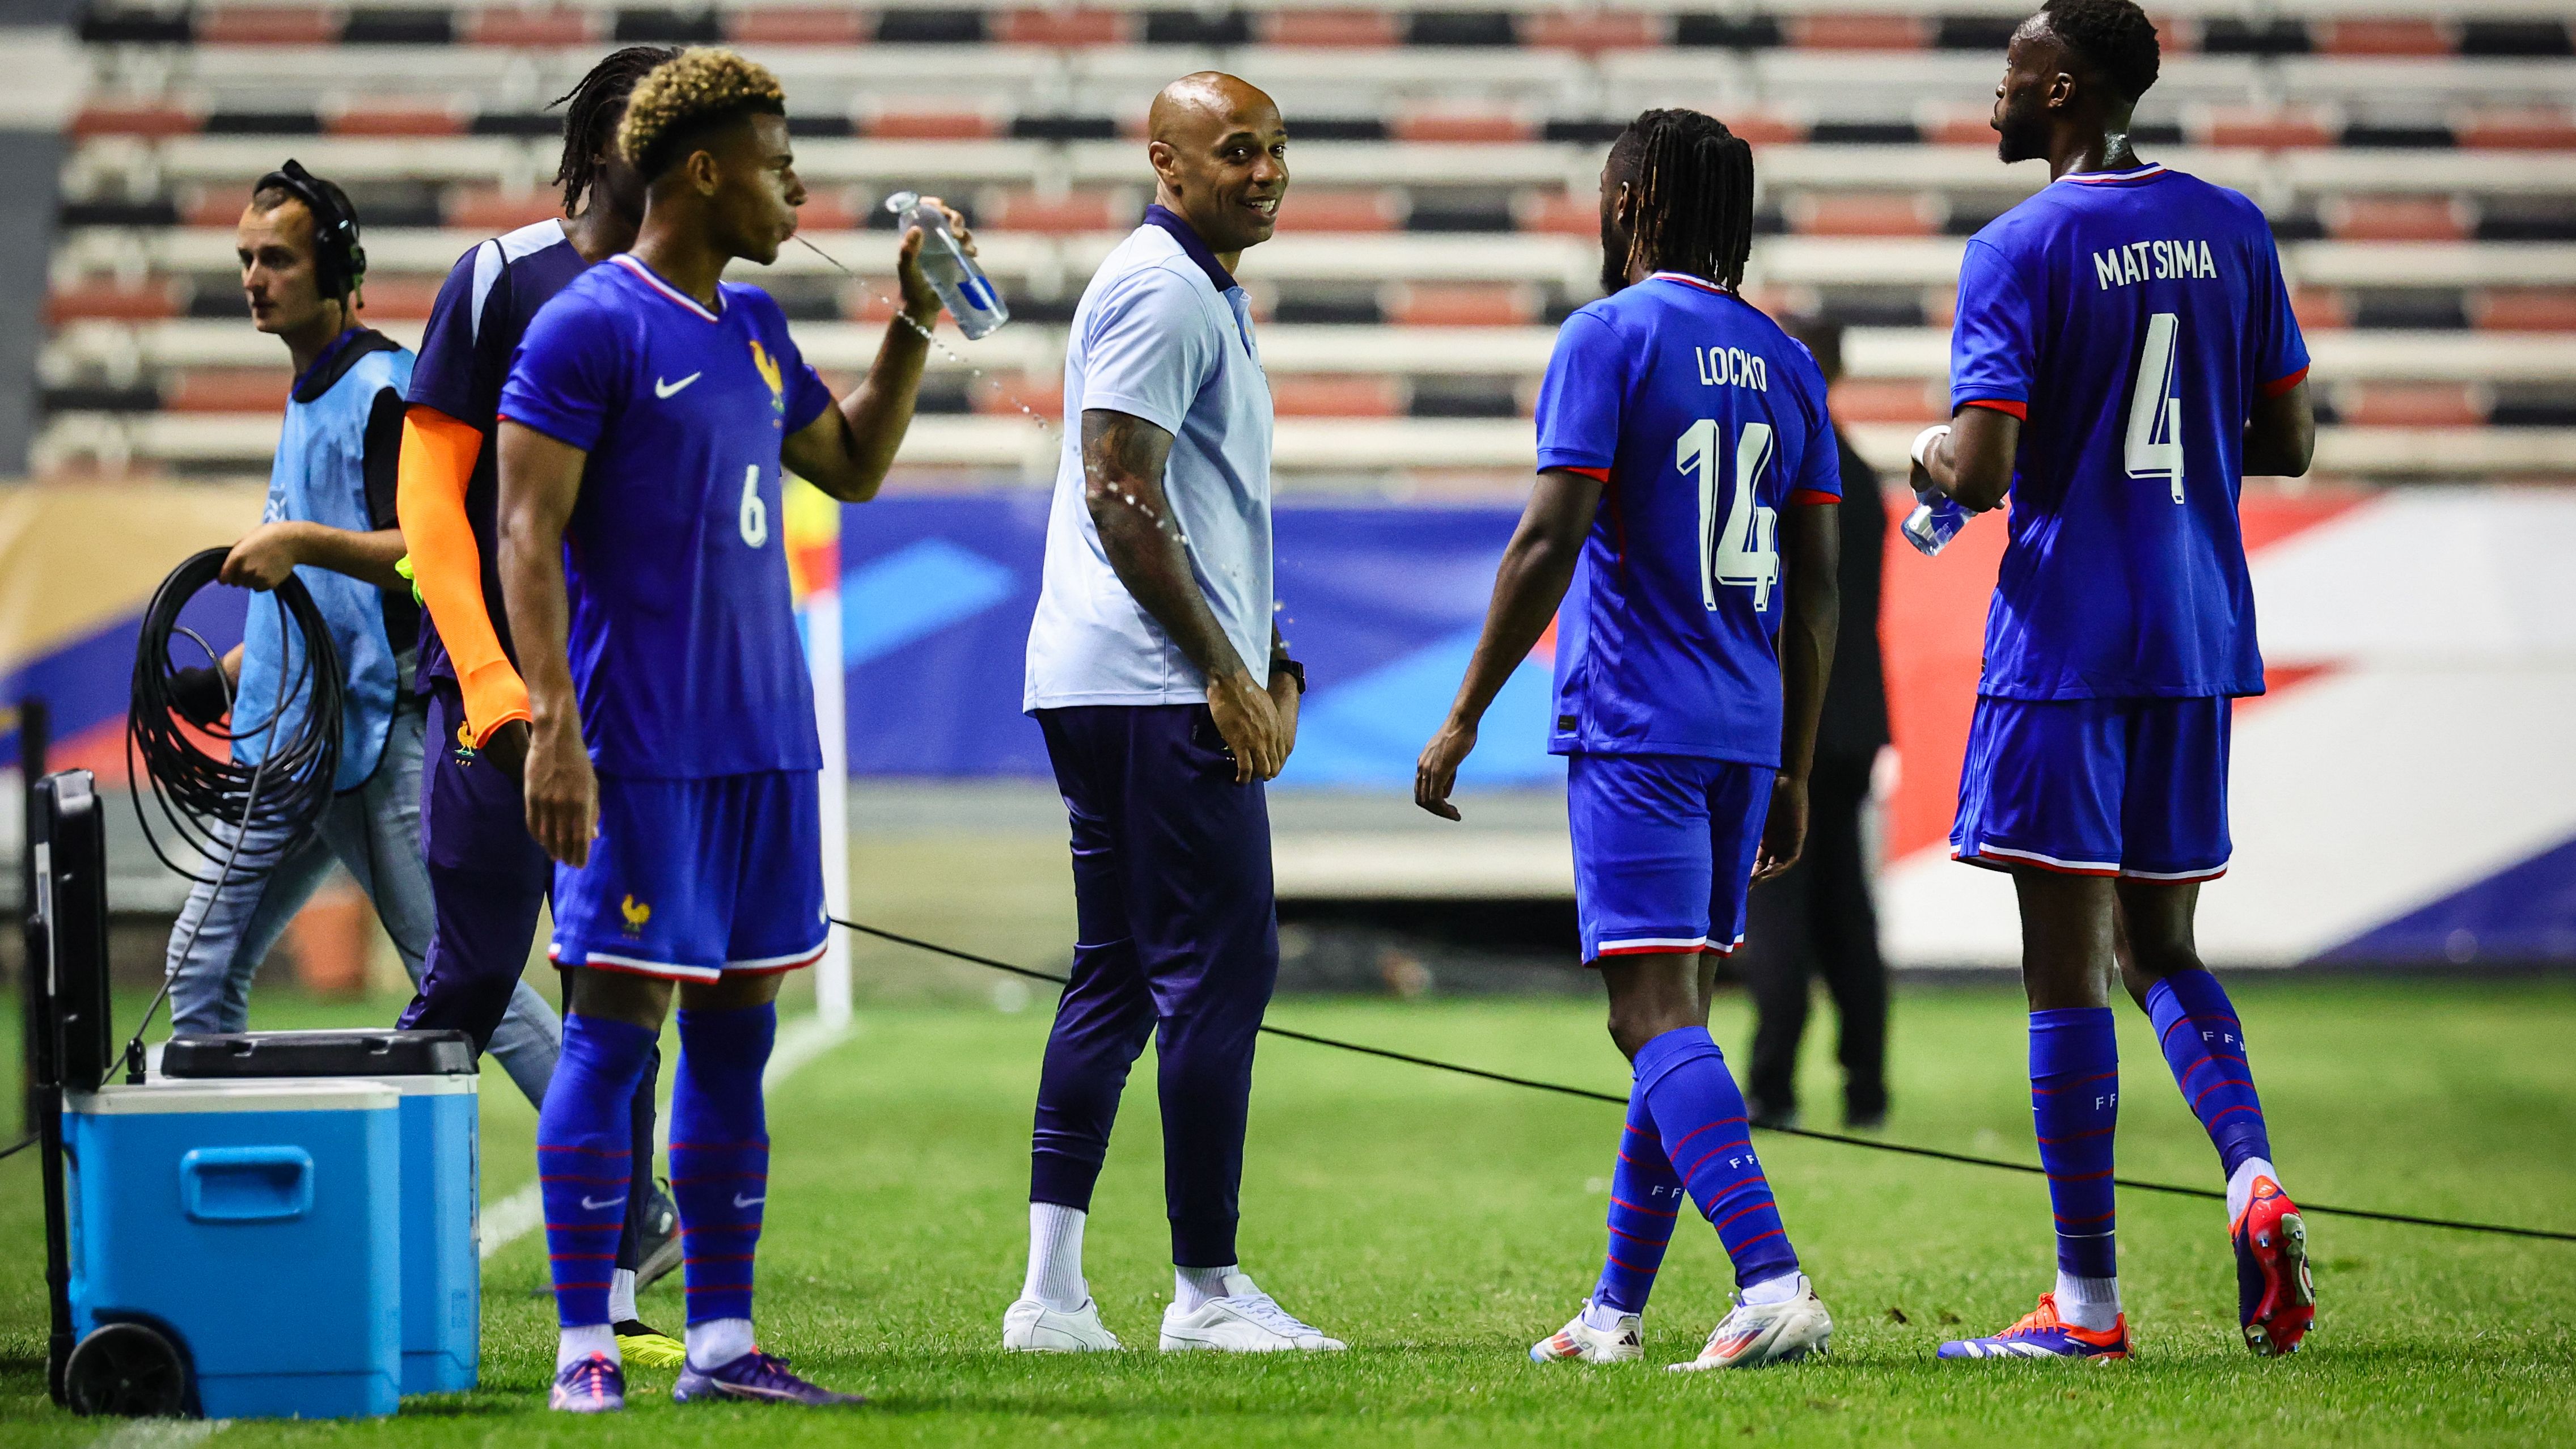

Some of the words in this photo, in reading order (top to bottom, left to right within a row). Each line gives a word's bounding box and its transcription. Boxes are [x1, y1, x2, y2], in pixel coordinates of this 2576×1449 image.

[2093, 240, 2217, 290] MATSIMA
[1695, 347, 1767, 392] LOCKO
[2124, 313, 2184, 504] 4
[739, 464, 768, 549] 6
[1676, 419, 1779, 612] 14
